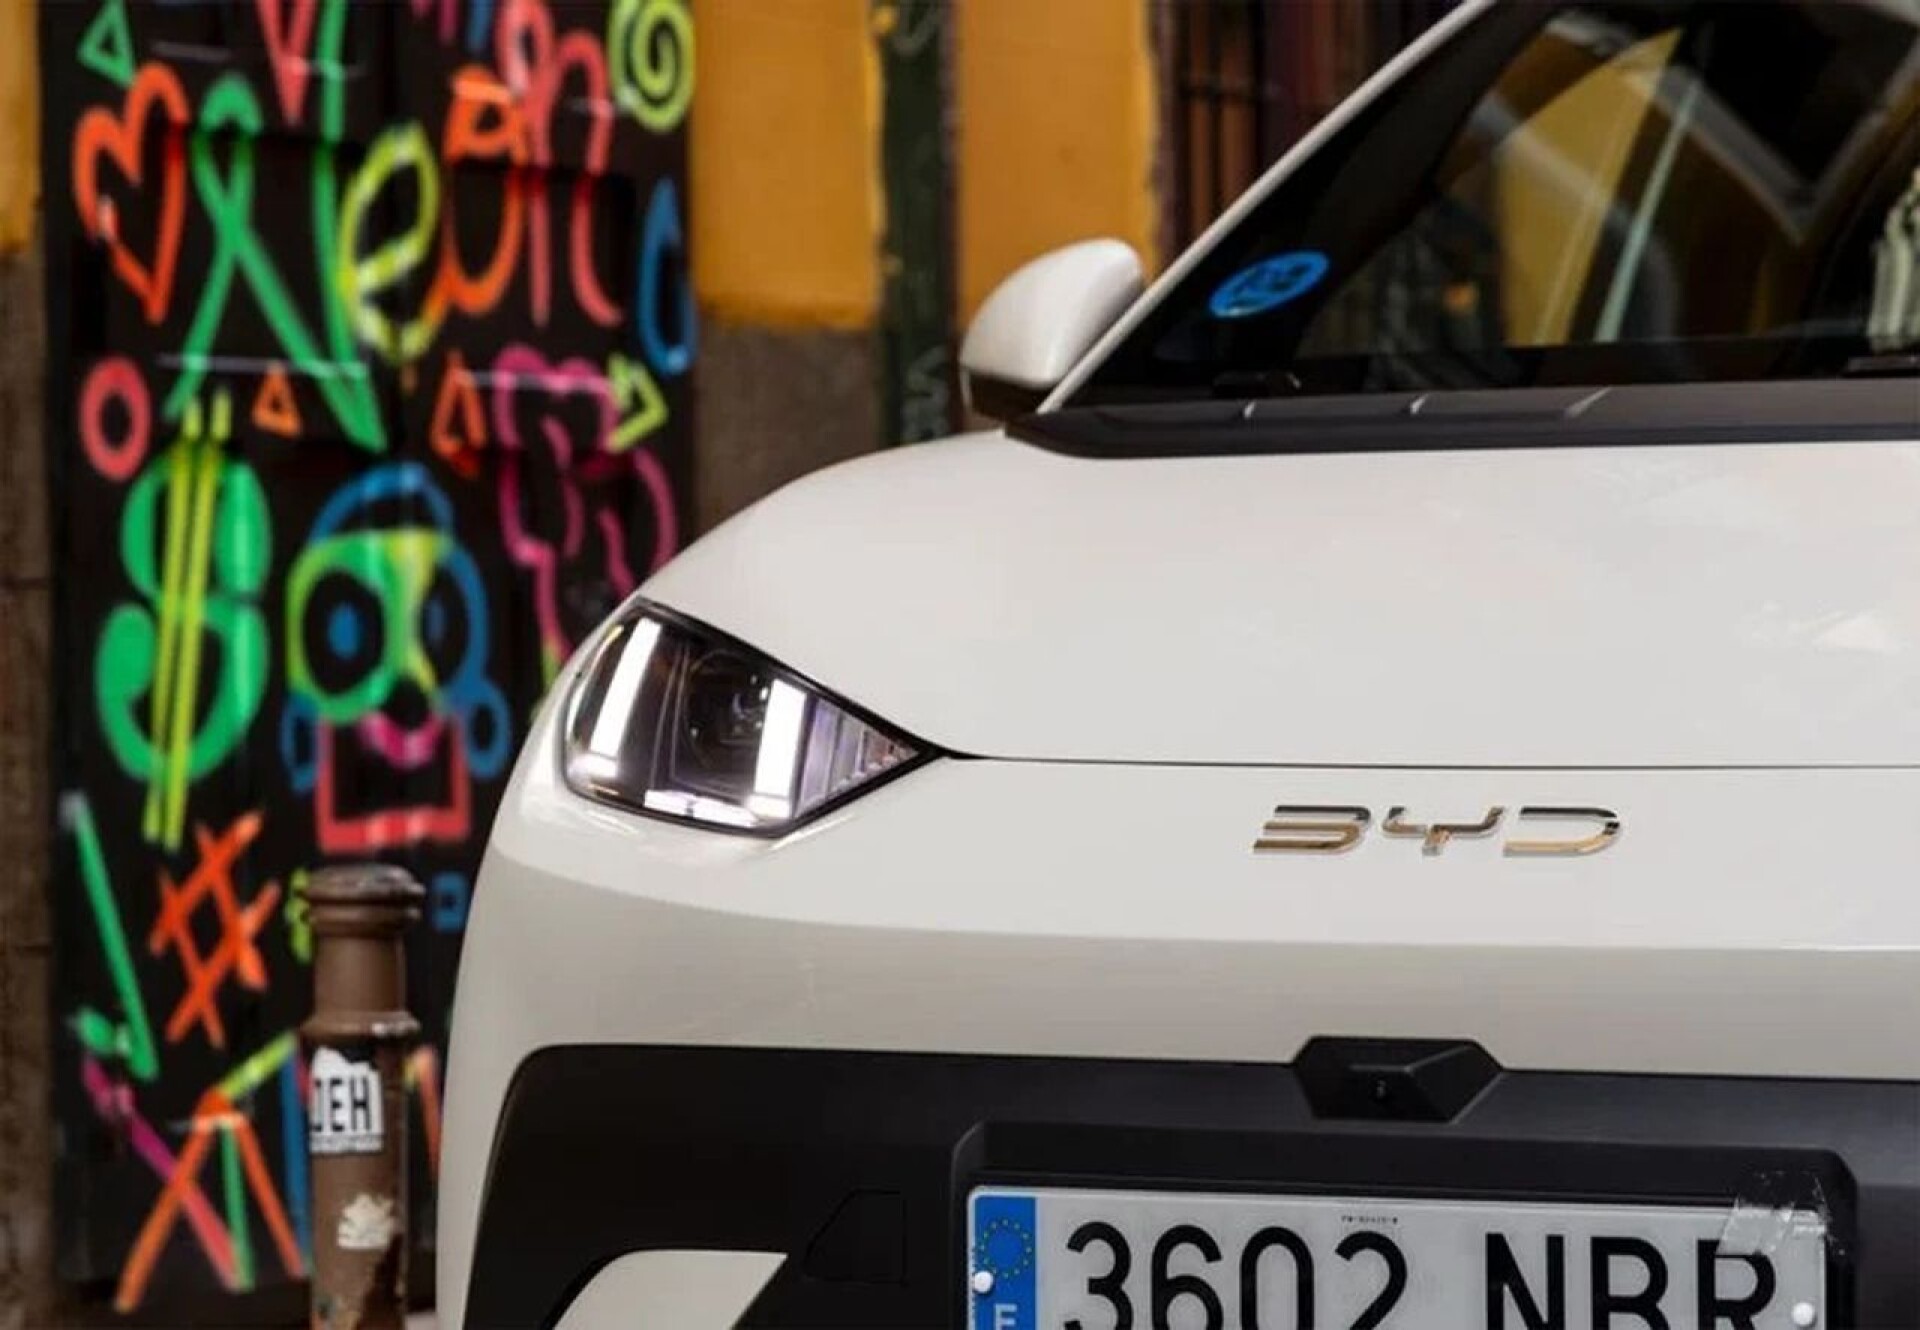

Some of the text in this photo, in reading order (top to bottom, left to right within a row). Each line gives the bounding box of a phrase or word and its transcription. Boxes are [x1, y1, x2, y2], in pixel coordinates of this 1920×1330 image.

[1253, 804, 1621, 857] BYD
[1063, 1221, 1777, 1330] 3602 NBR
